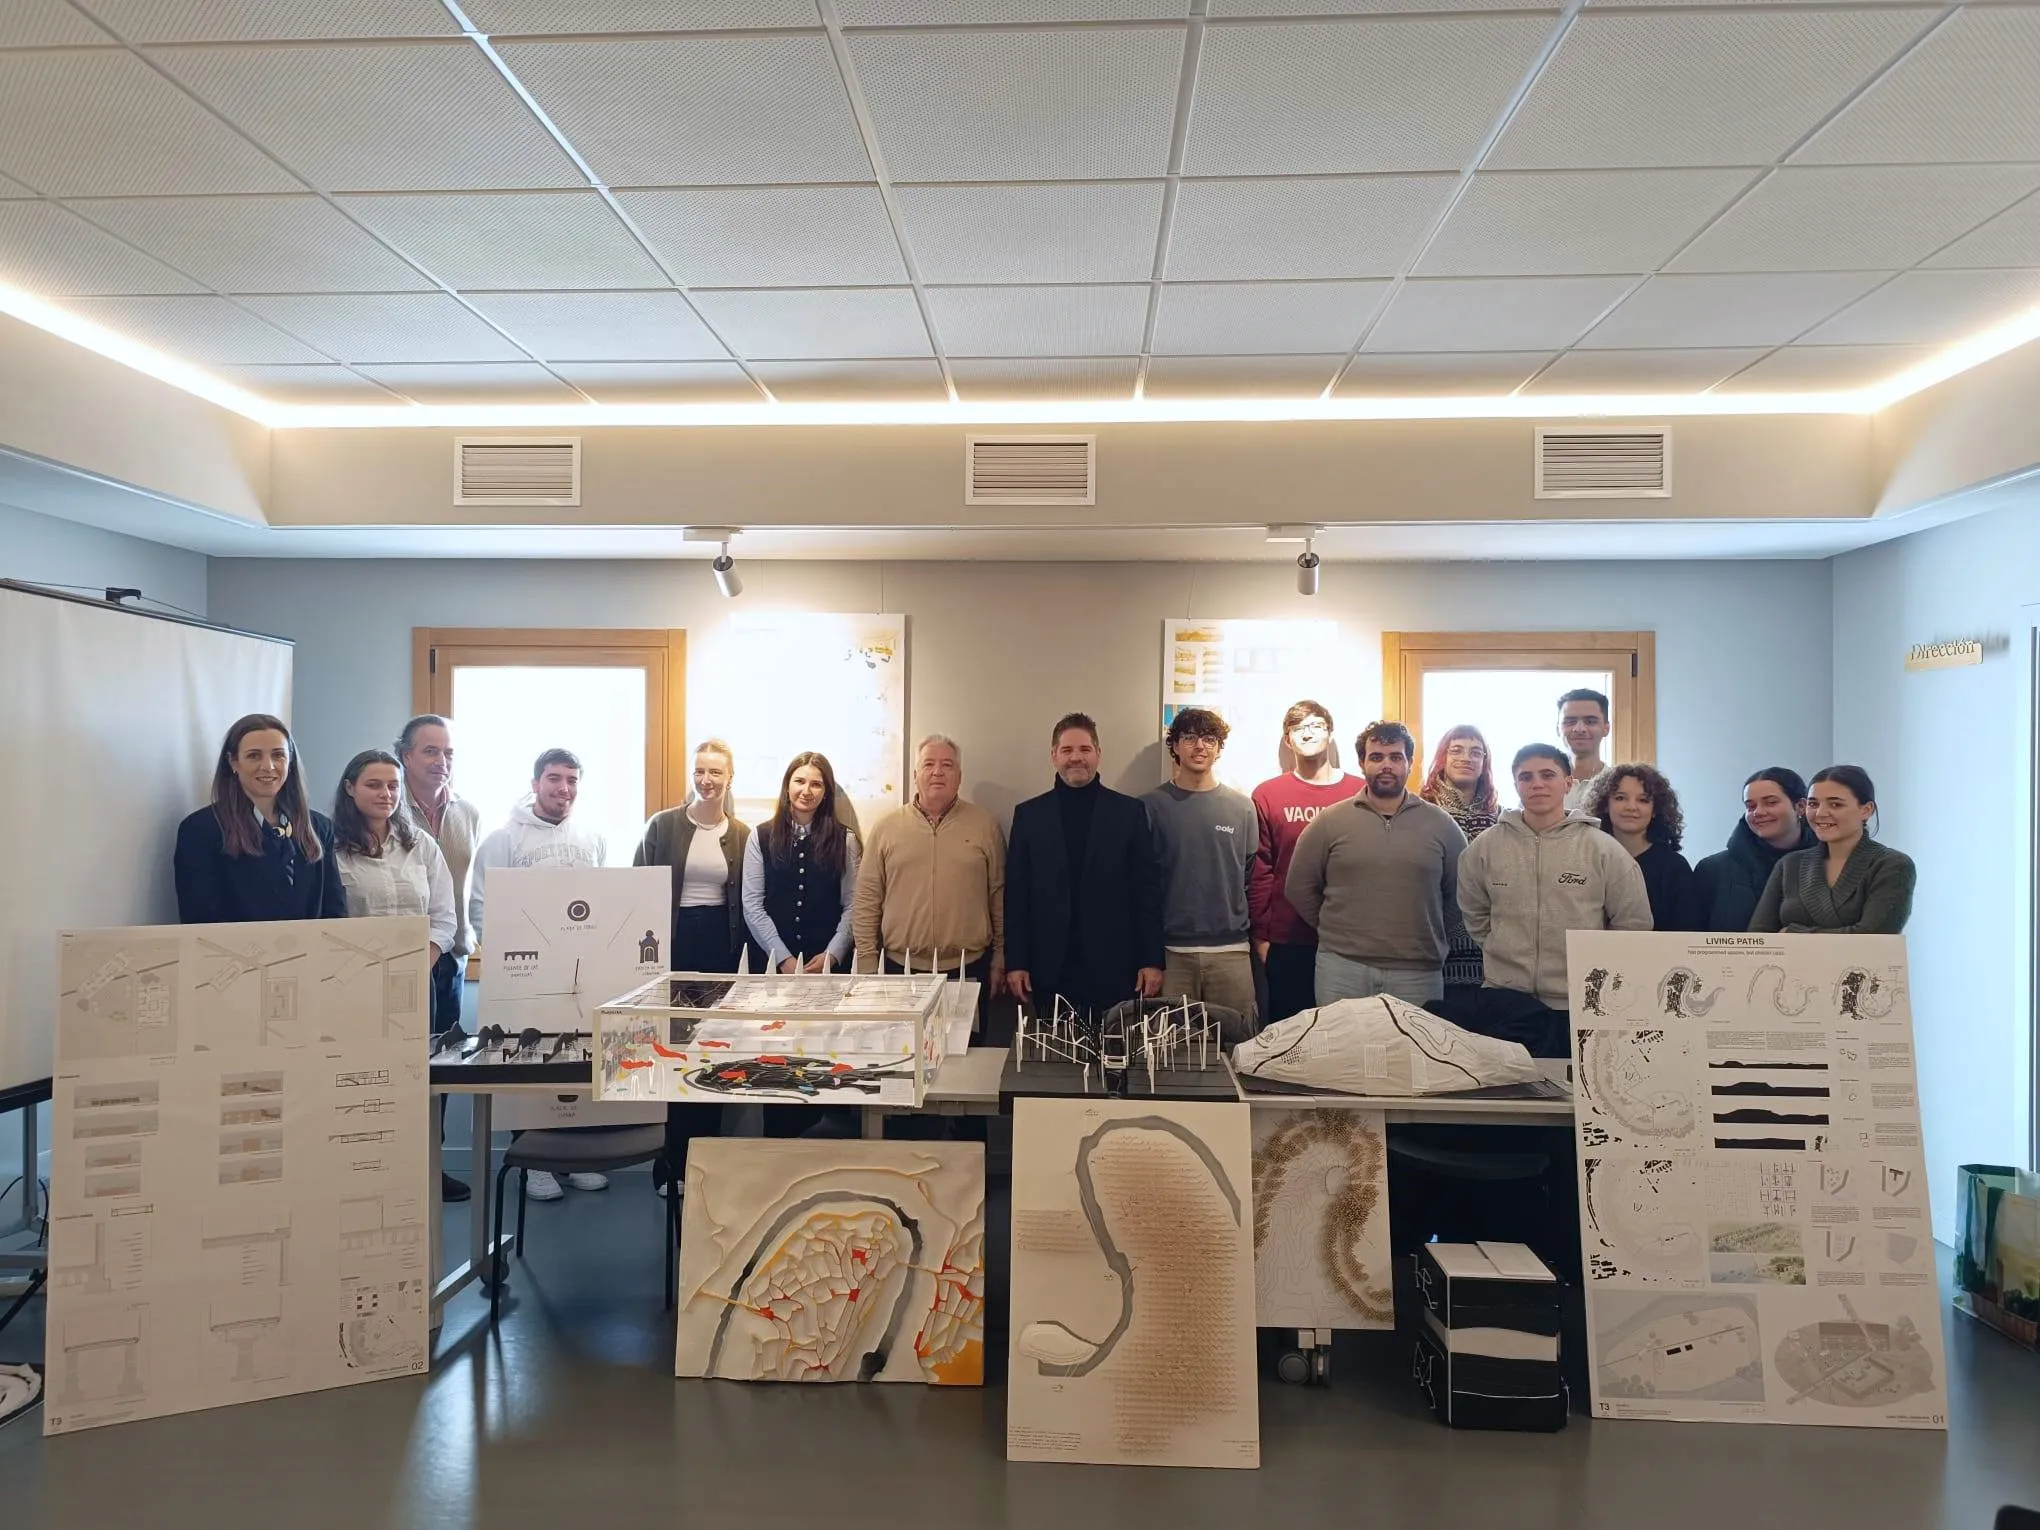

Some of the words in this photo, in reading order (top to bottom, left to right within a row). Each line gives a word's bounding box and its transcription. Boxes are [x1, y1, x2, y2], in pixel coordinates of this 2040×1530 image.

[1911, 638, 1975, 661] Dirección
[1558, 872, 1587, 886] Ford
[1705, 937, 1735, 946] LIVING
[1736, 937, 1765, 946] PATHS
[411, 1361, 424, 1371] 02
[1598, 1402, 1610, 1411] T3
[1932, 1414, 1944, 1424] 01
